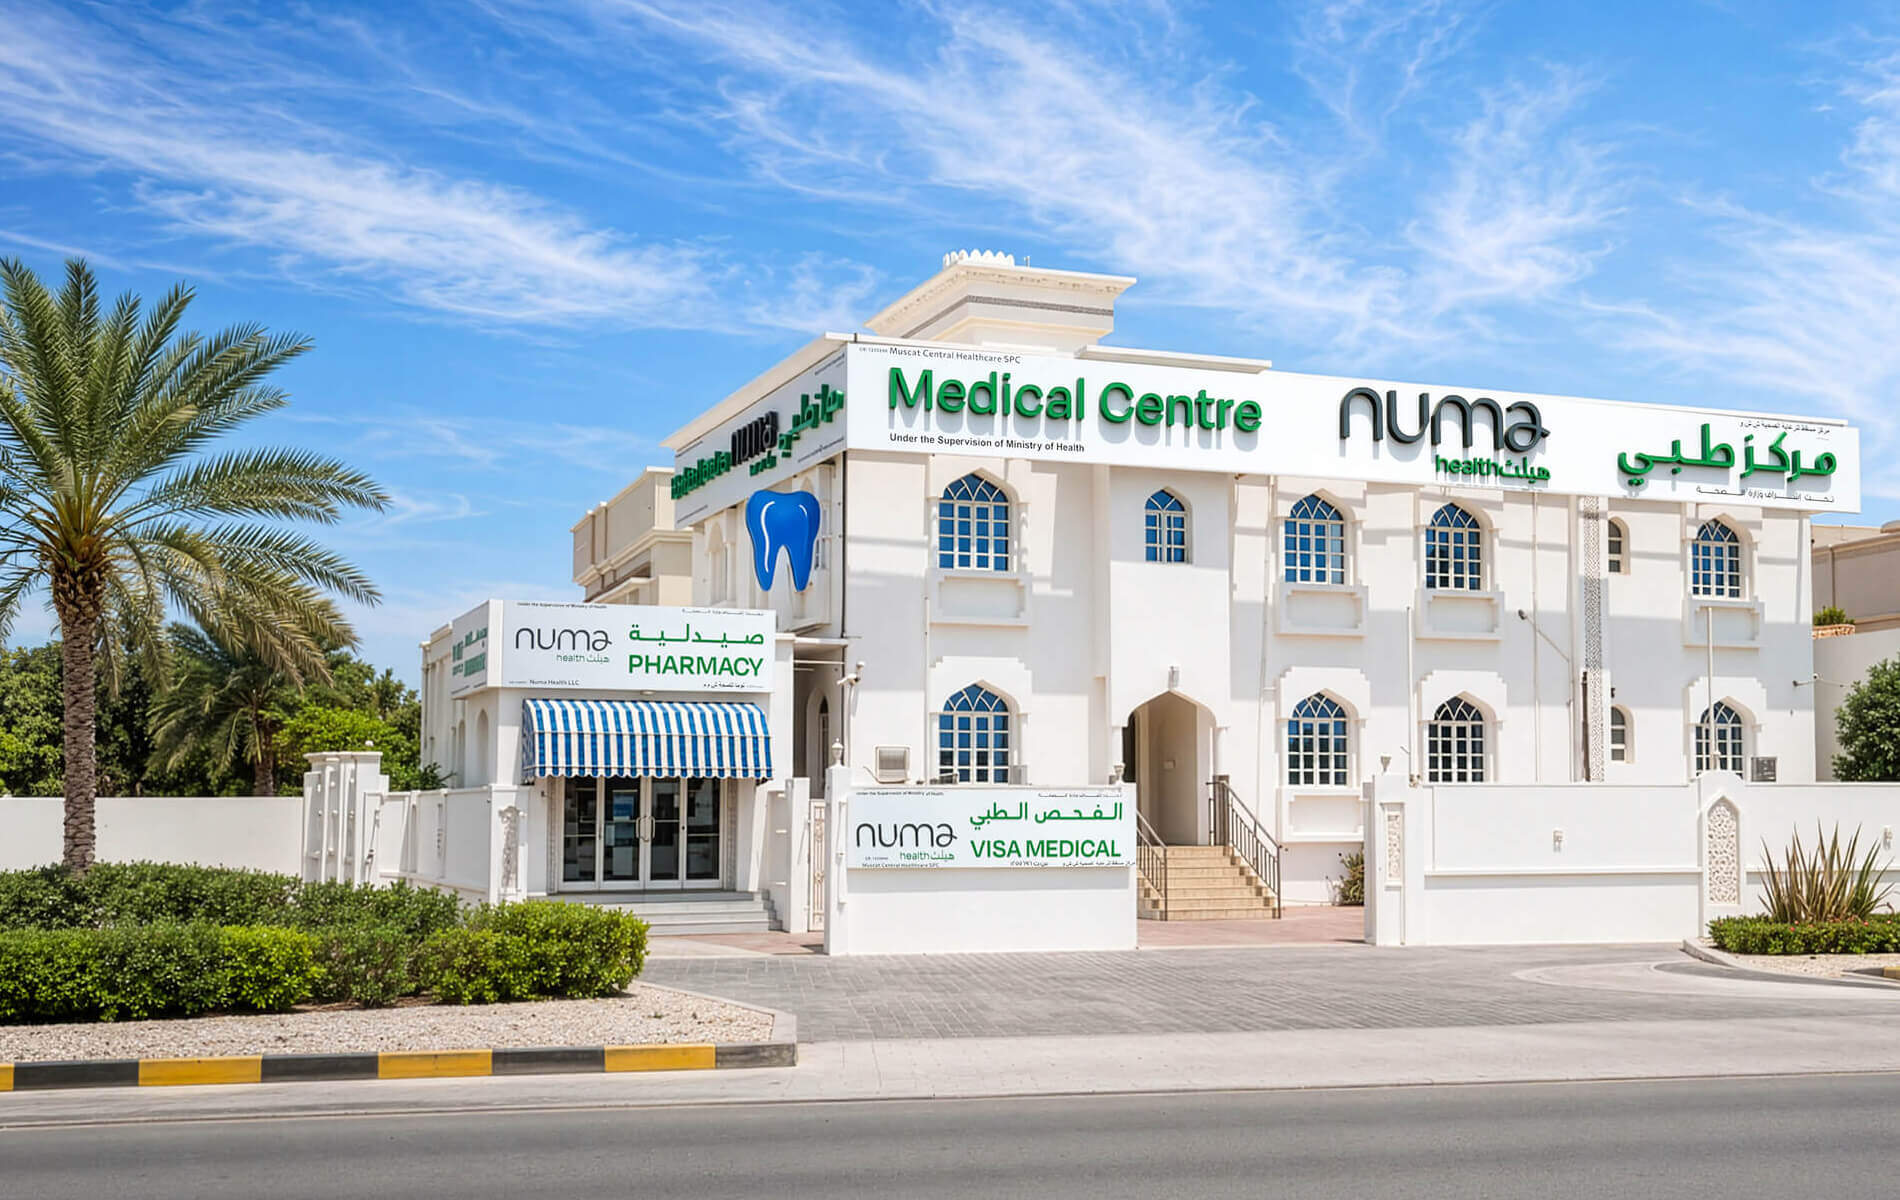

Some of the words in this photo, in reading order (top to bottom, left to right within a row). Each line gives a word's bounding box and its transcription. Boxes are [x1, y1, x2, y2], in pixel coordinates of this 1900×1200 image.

[889, 347, 921, 357] Muscat
[922, 349, 954, 360] Central
[956, 352, 1002, 363] Healthcare
[1004, 355, 1021, 364] SPC
[888, 367, 1086, 421] Medical
[1099, 381, 1263, 432] Centre
[1339, 386, 1551, 453] numa
[889, 433, 918, 443] Under
[920, 435, 935, 444] the
[937, 436, 992, 447] Supervision
[994, 438, 1004, 448] of
[1006, 438, 1042, 451] Ministry
[1044, 441, 1054, 451] of
[1056, 442, 1085, 453] Health
[1617, 423, 1735, 487] طبي
[1435, 454, 1499, 477] health
[1739, 431, 1837, 482] مركز
[515, 627, 612, 652] numa
[628, 623, 765, 648] صيدلية
[556, 654, 585, 663] health
[628, 653, 765, 677] PHARMACY
[969, 802, 1028, 831] الطبي
[1034, 802, 1123, 825] الفحص
[855, 822, 958, 848] numa
[899, 851, 929, 860] health
[970, 839, 1024, 859] VISA
[1025, 839, 1122, 859] MEDICAL
